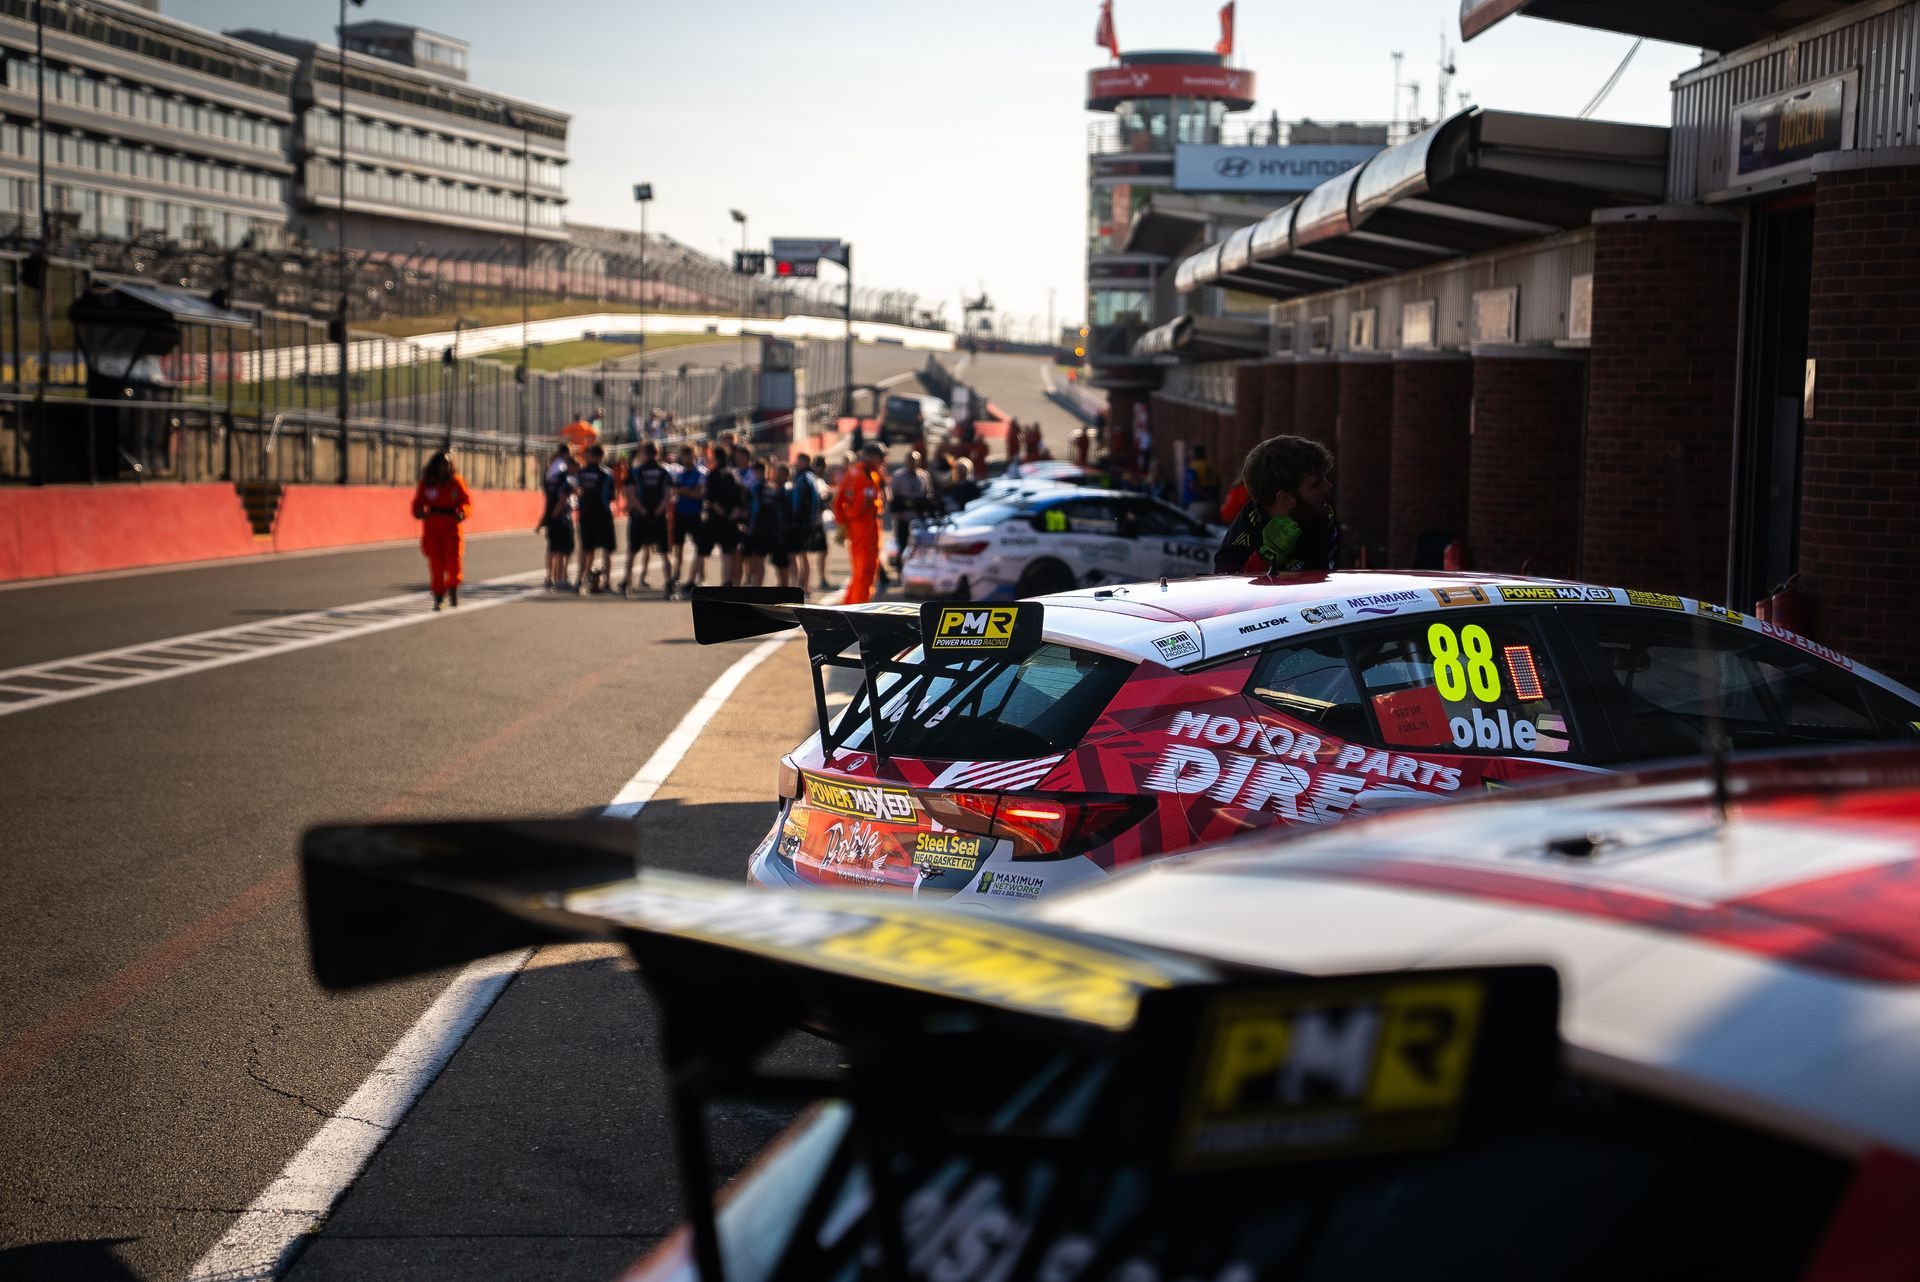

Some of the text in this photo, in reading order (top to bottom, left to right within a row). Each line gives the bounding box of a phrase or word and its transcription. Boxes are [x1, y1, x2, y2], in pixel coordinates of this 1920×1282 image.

[1778, 104, 1825, 151] DORLIN
[1259, 159, 1359, 176] HYUNDA
[1164, 541, 1209, 562] LKQ
[1346, 591, 1420, 608] METAMARK
[1502, 586, 1610, 601] POWER MAXED
[1628, 590, 1655, 599] Steel
[940, 612, 1013, 635] PMR
[1162, 641, 1192, 653] TIMBER
[1166, 646, 1196, 658] PRODUCTS
[1427, 623, 1501, 702] 88
[1449, 708, 1537, 750] oble
[1167, 711, 1463, 791] MOTOR PARTS
[1142, 744, 1400, 825] DIRE
[807, 779, 912, 820] POWER MAXED
[916, 832, 980, 856] Steel Seal
[914, 853, 975, 869] HEAD GASKET FIX
[993, 882, 1041, 895] NETWORKS
[996, 873, 1044, 887] MAXIMUM
[1212, 1005, 1457, 1109] PMR
